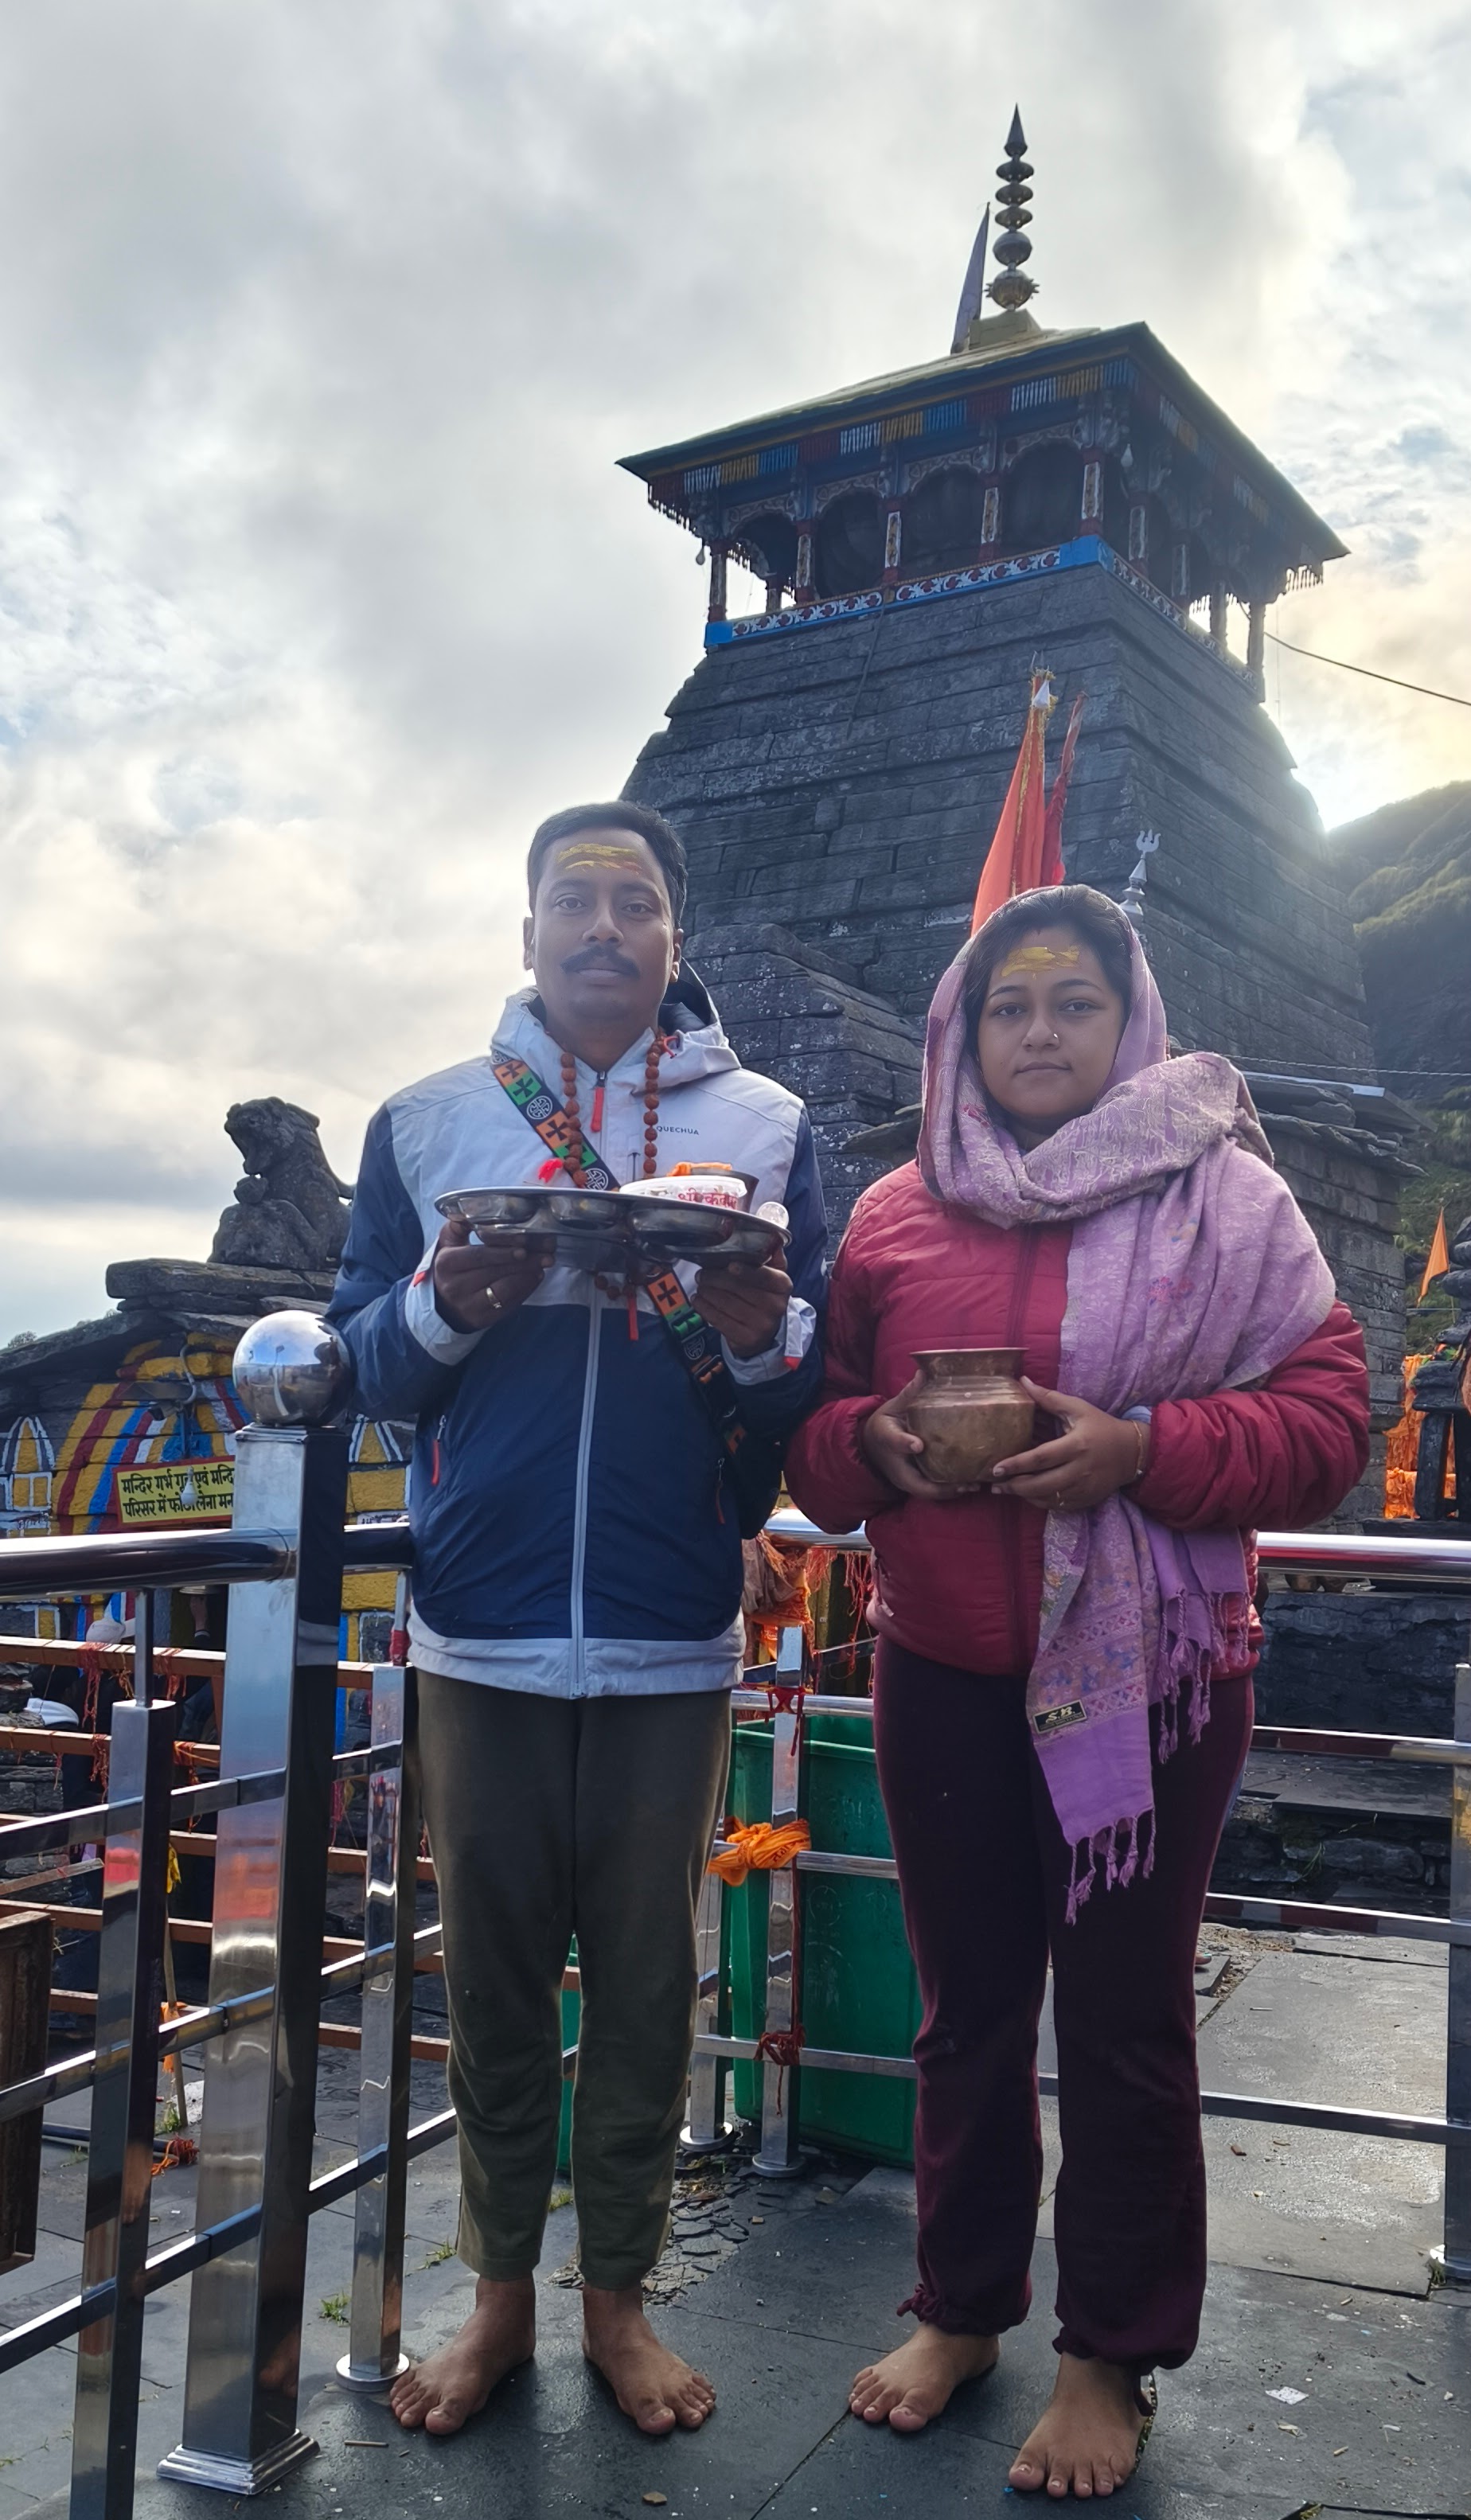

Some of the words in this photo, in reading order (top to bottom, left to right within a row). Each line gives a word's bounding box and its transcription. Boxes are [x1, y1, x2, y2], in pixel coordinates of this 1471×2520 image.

[656, 1125, 700, 1135] QUECHUA
[121, 1473, 154, 1495] मन्दिर
[154, 1469, 174, 1491] गर्भ
[193, 1466, 209, 1489] एवं
[209, 1464, 236, 1485] मन्दि
[123, 1497, 157, 1518] परिसर
[156, 1492, 167, 1513] में
[196, 1489, 217, 1511] लेना
[217, 1492, 234, 1509] मन
